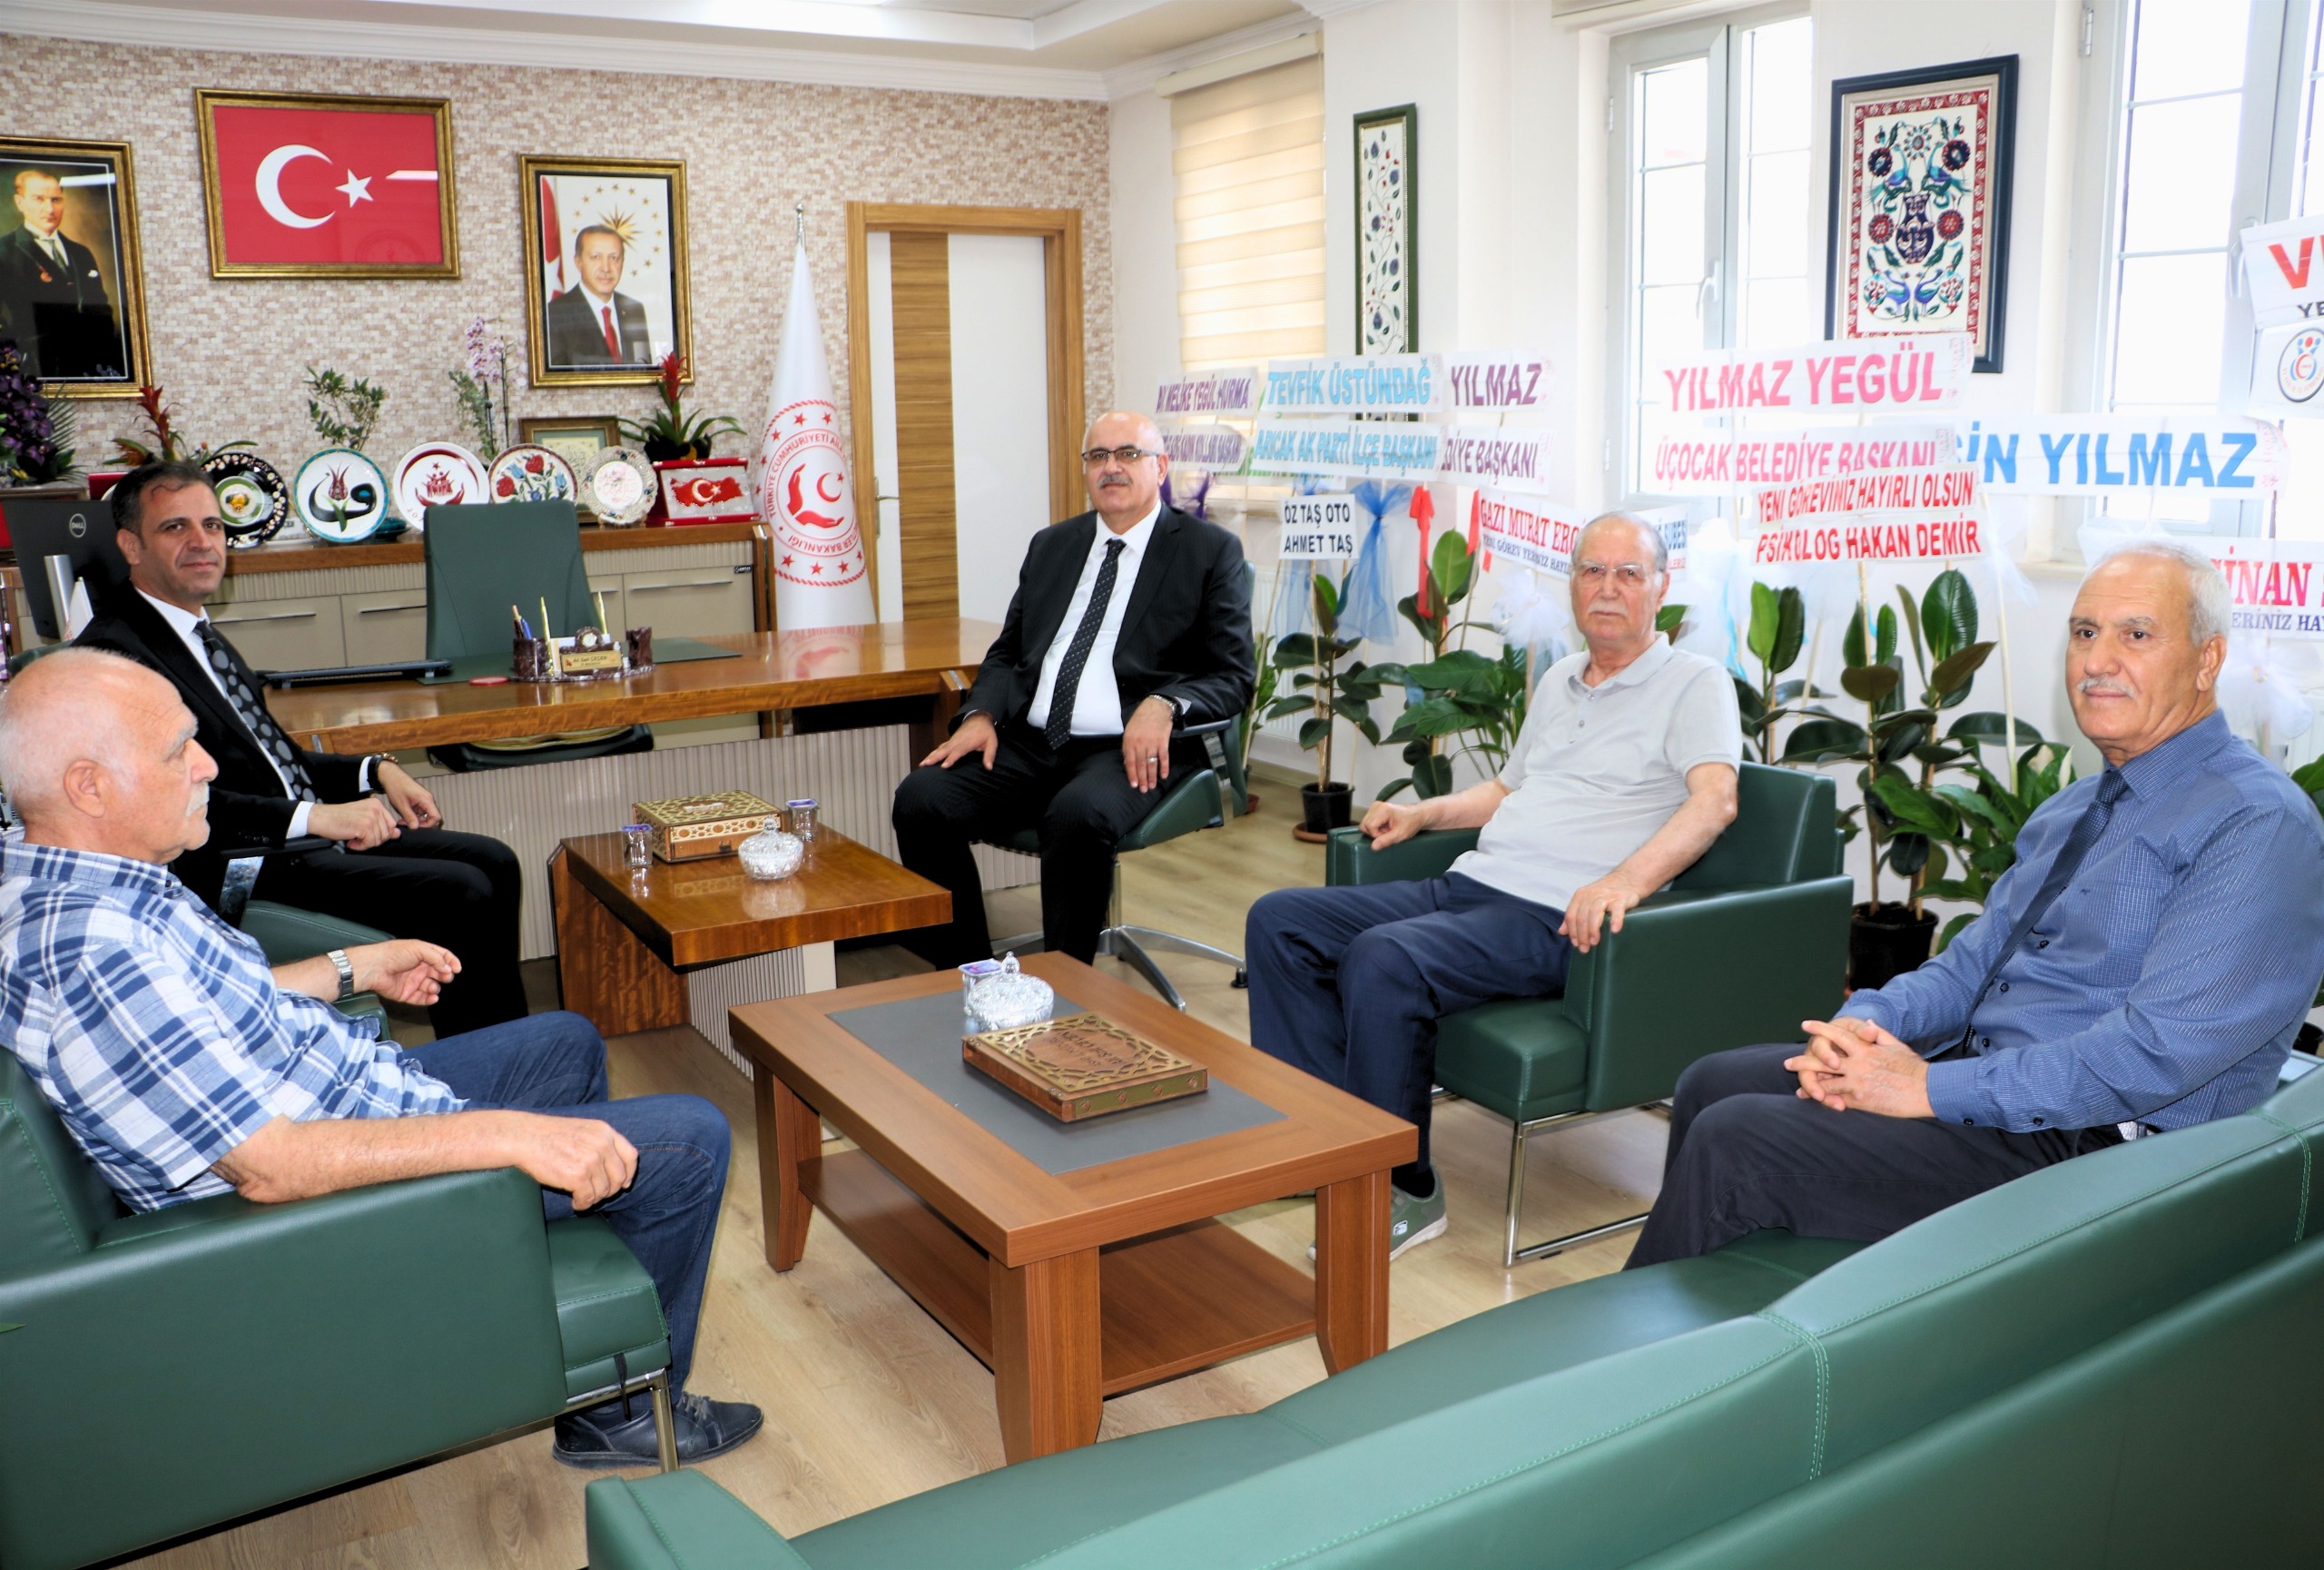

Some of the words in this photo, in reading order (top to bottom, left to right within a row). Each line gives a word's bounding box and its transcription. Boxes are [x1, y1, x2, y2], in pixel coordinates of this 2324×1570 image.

[2268, 234, 2324, 289] V
[1267, 361, 1325, 405] TEVFİK
[1328, 358, 1432, 405] ÜSTÜNDAĞ
[1452, 363, 1542, 406] YILMAZ
[1663, 360, 1794, 411] YILMAZ
[1806, 342, 1945, 404] YEGÜL
[772, 432, 829, 472] CUMHURİYETİ
[1475, 440, 1538, 485] BAŞKANI
[1656, 436, 1732, 490] ÜÇOCAK
[1736, 432, 1834, 482] BELEDİYE
[2039, 431, 2258, 489] YILMAZ
[1856, 473, 1918, 509] HAYIRLI
[1922, 470, 1974, 507] OLSUN
[1285, 501, 1297, 524] ÖZ
[1301, 504, 1322, 528] TAŞ
[1326, 502, 1350, 523] OTO
[1481, 495, 1506, 533] GAZİ
[1508, 507, 1551, 547] MURAT
[1846, 523, 1911, 558] HAKAN
[1916, 511, 1981, 556] DEMİR
[1284, 534, 1324, 553] AHMET
[1328, 534, 1353, 558] TAŞ
